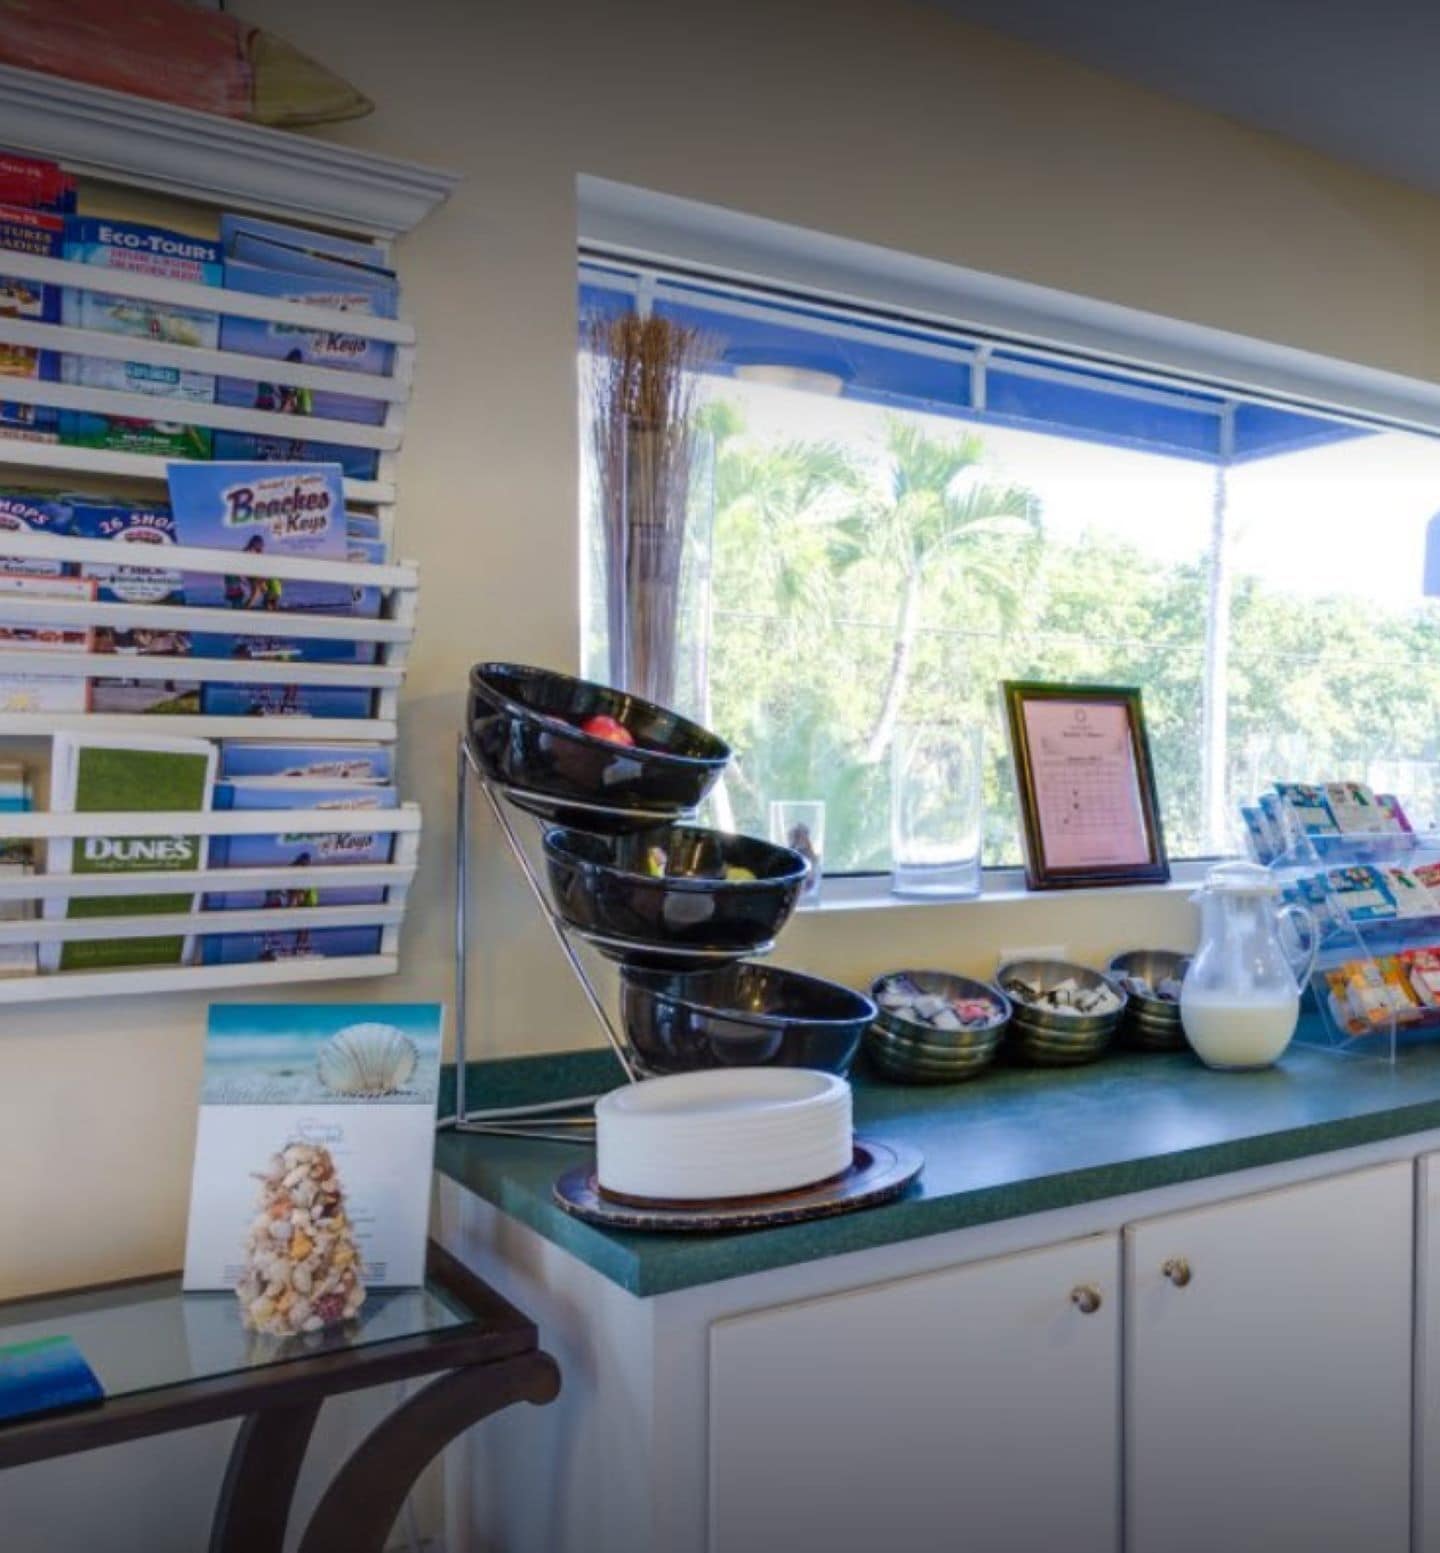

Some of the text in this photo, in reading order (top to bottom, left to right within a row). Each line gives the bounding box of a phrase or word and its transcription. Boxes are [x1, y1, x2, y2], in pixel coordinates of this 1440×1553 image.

[227, 487, 329, 524] Beaches
[286, 513, 327, 535] Keys
[85, 836, 193, 860] DUNES
